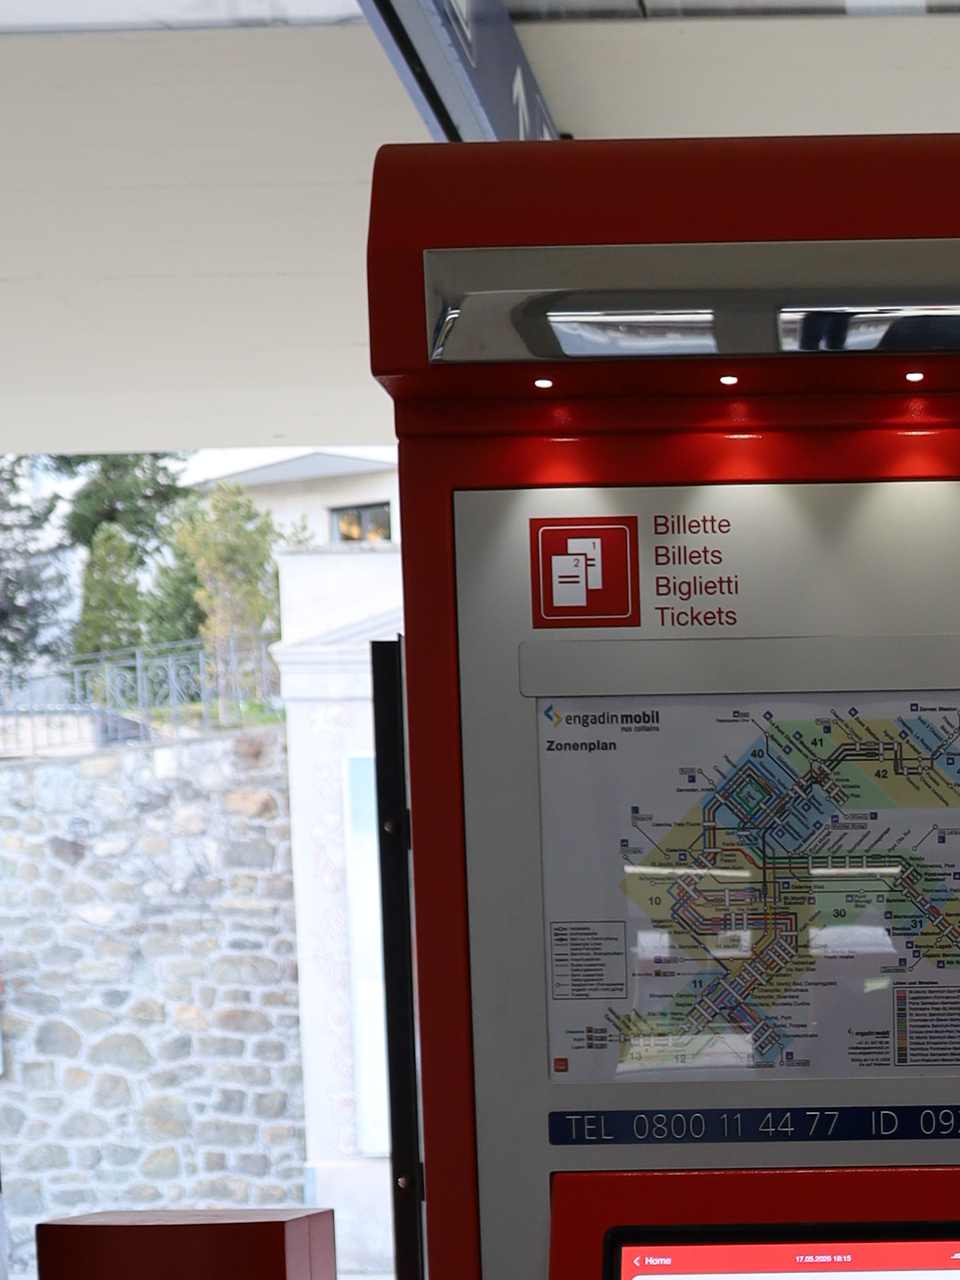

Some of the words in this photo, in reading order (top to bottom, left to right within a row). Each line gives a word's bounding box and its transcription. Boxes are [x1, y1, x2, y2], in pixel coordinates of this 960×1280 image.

[653, 514, 731, 535] Billette
[655, 545, 723, 566] Billets
[655, 574, 739, 601] Biglietti
[655, 606, 737, 626] Tickets
[546, 740, 617, 753] Zonenplan
[811, 737, 825, 748] 41
[750, 749, 765, 759] 40
[874, 768, 888, 779] 42
[832, 908, 847, 918] 30
[910, 919, 924, 930] 31
[565, 1114, 615, 1140] TEL
[632, 1112, 706, 1140] 0800
[719, 1111, 743, 1137] 11
[758, 1111, 795, 1137] 44
[805, 1110, 840, 1136] 77
[871, 1110, 899, 1136] ID
[645, 1256, 672, 1266] Home
